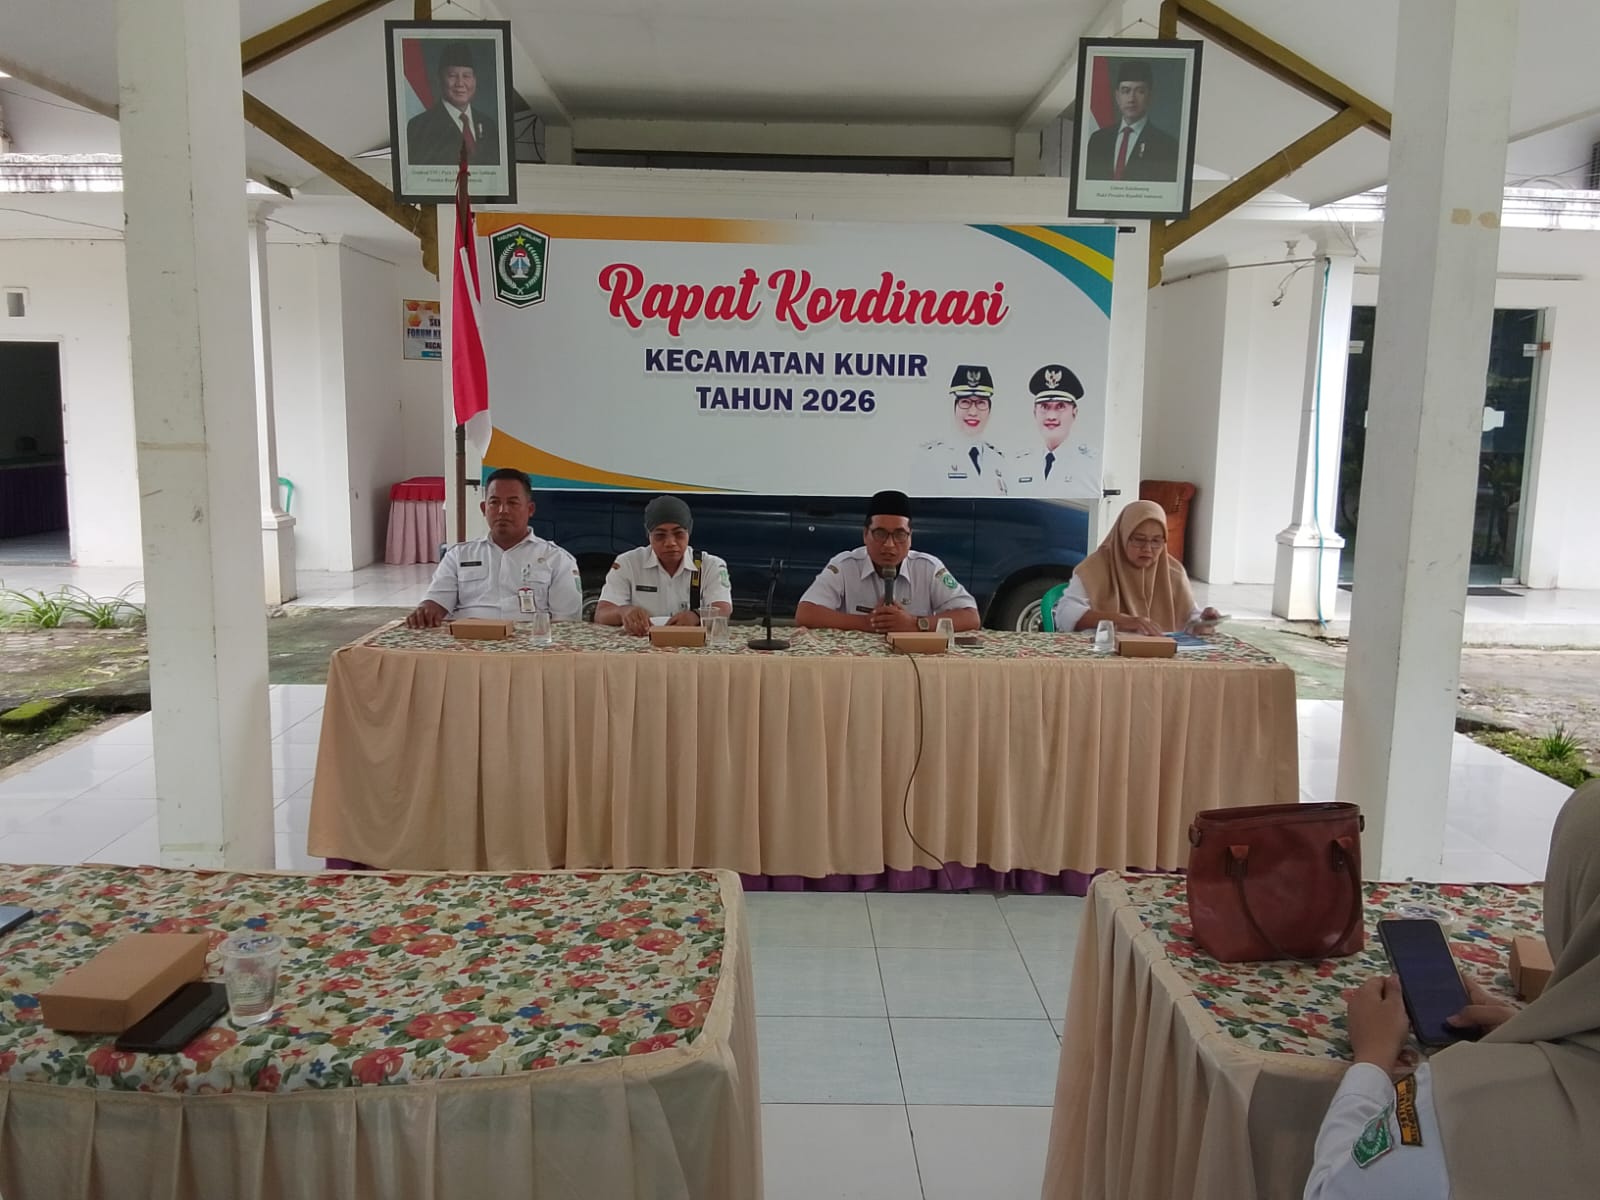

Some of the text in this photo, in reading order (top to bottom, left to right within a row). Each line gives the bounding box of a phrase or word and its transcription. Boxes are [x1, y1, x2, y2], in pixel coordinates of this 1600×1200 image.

[598, 263, 1009, 337] Rapat Kordinasi
[407, 328, 432, 337] FORUM
[645, 348, 928, 377] KECAMATAN KUNIR
[695, 386, 876, 412] TAHUN 2026
